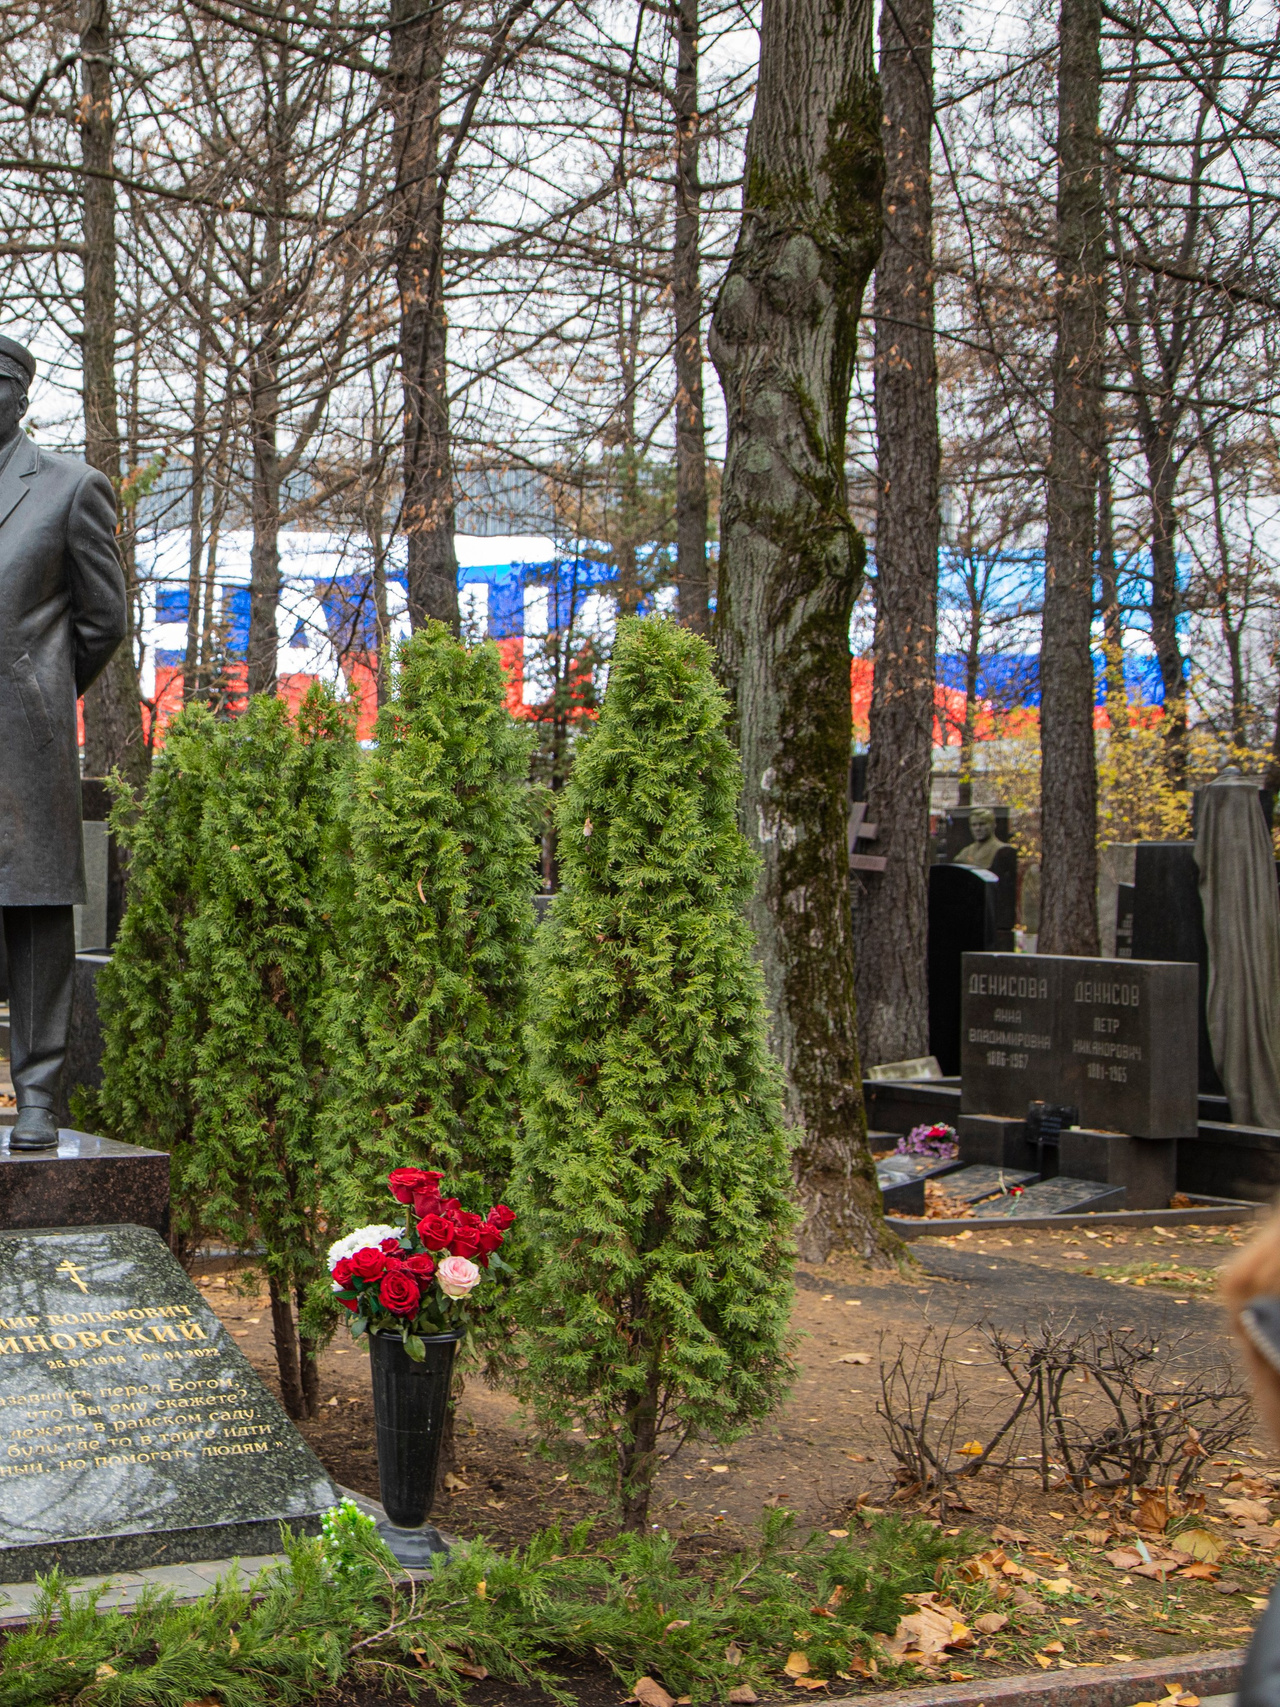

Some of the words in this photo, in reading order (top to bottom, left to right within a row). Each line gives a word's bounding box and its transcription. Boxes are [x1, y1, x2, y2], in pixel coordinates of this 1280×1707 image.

[969, 974, 1048, 999] ДЕНИСОВА
[1074, 981, 1140, 1007] ДЕНИСОВ
[993, 1008, 1022, 1023] АННА
[1093, 1017, 1120, 1033] ПЕТР
[969, 1028, 1051, 1050] ВЛАДИМИРОВНА
[1072, 1039, 1142, 1060] НИКАНОРОВИЧ
[46, 1305, 193, 1327] ВОЛЬФОВИЧ
[100, 1384, 162, 1400] перед
[168, 1376, 241, 1393] Богом,
[26, 1409, 63, 1421] что
[70, 1402, 103, 1418] Вы
[109, 1402, 148, 1414] ему
[155, 1388, 248, 1410] скажете?
[10, 1424, 88, 1440] лежать
[93, 1421, 107, 1433] в
[112, 1411, 203, 1434] райском
[208, 1408, 263, 1424] саду.
[7, 1442, 59, 1459] буду
[65, 1439, 101, 1451] где
[107, 1435, 133, 1448] то
[140, 1434, 153, 1446] в
[158, 1428, 217, 1443] тайге
[223, 1424, 273, 1438] идти
[59, 1458, 87, 1472] но
[95, 1449, 195, 1469] помогать
[201, 1441, 269, 1458] людям
